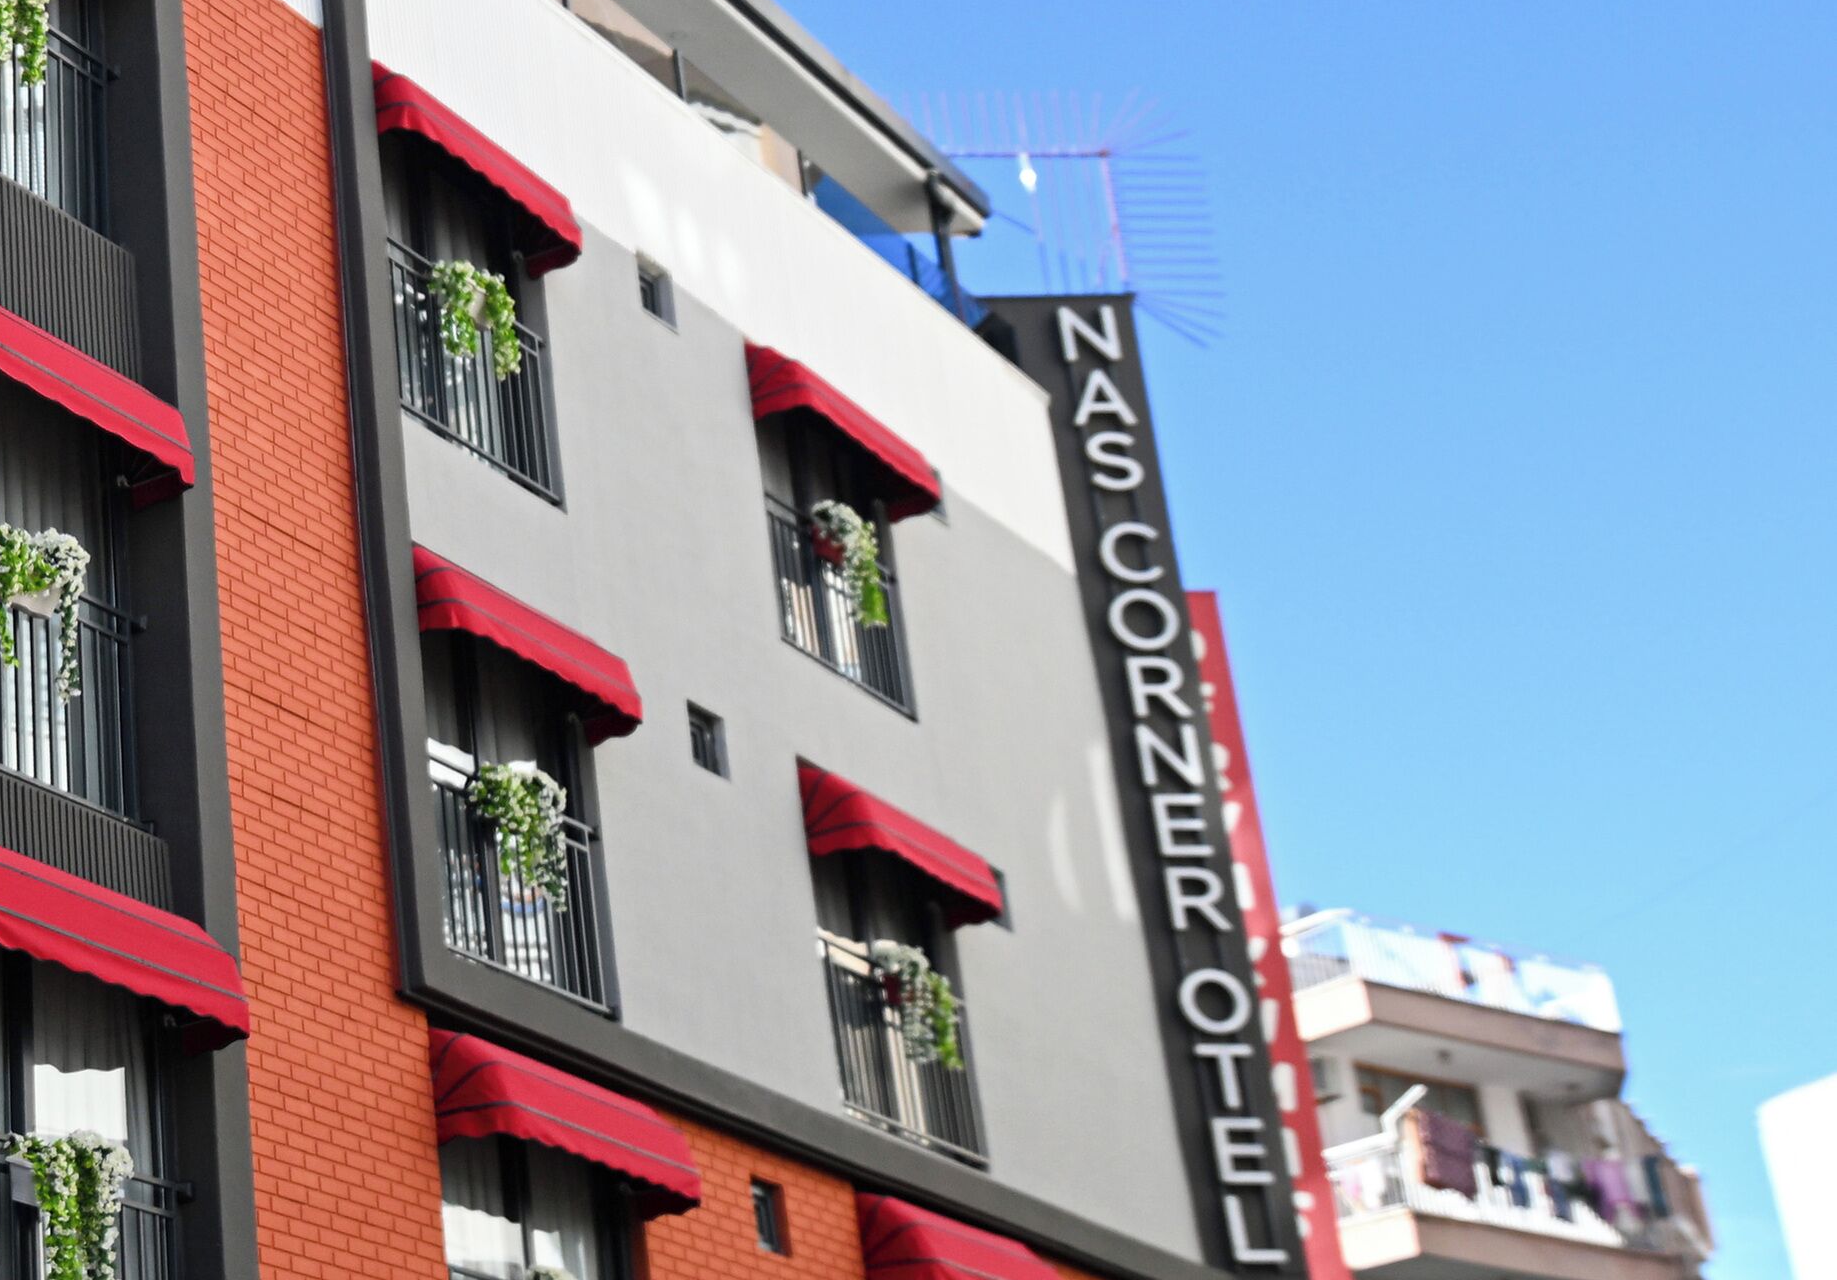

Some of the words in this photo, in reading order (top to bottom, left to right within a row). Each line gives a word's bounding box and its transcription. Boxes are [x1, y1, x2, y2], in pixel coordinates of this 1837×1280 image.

[1056, 304, 1146, 492] NAS
[1099, 521, 1232, 932] CORNER
[1177, 966, 1290, 1265] OTEL
